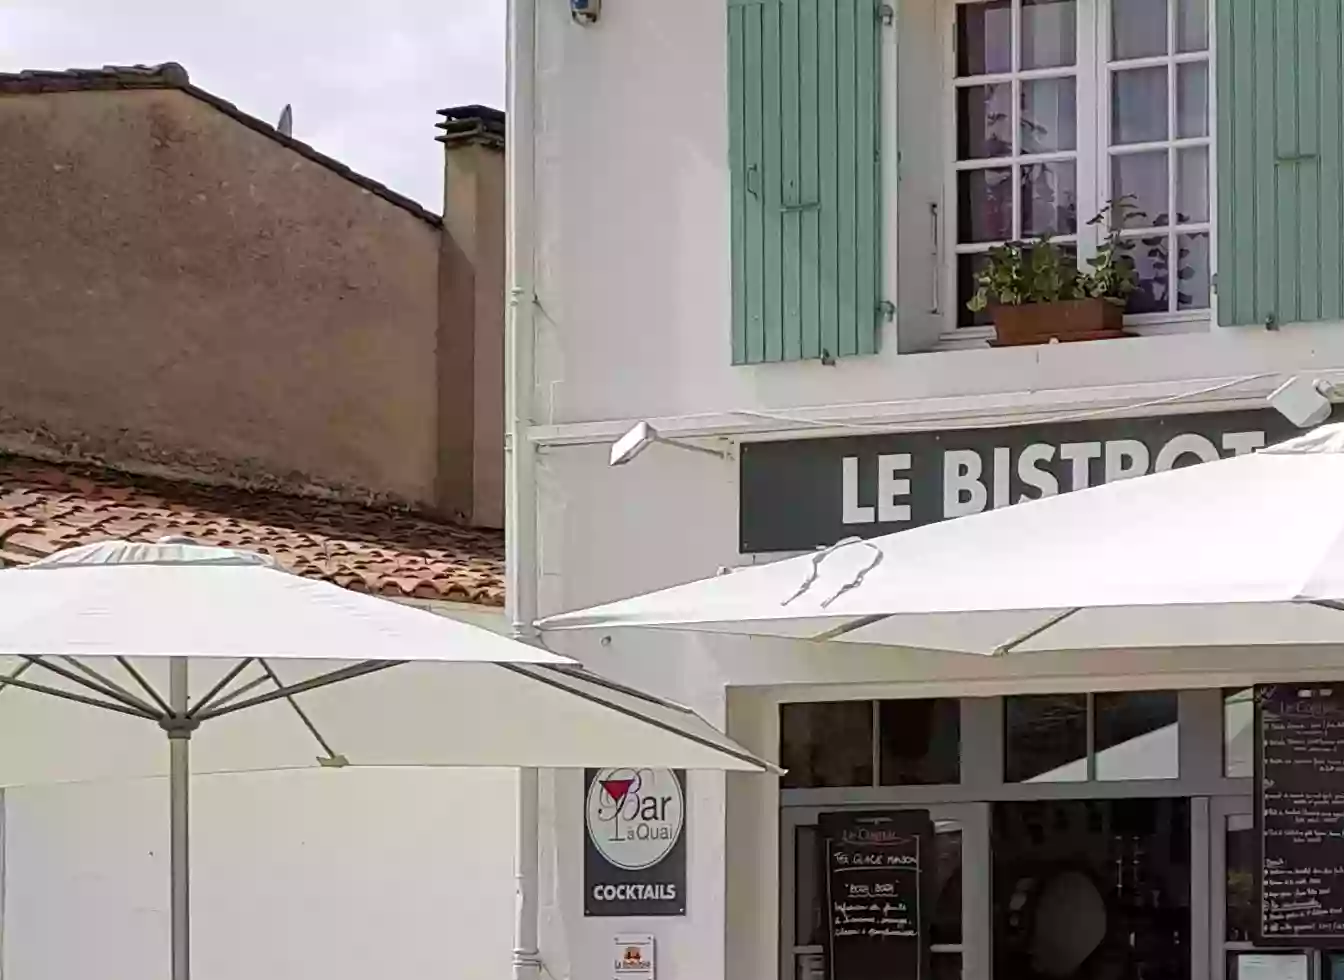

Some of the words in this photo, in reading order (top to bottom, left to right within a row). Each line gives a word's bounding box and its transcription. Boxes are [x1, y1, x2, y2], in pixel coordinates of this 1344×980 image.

[842, 453, 912, 524] LE
[598, 768, 672, 822] Bar
[636, 823, 673, 841] Quai
[593, 884, 677, 901] COCKTAILS
